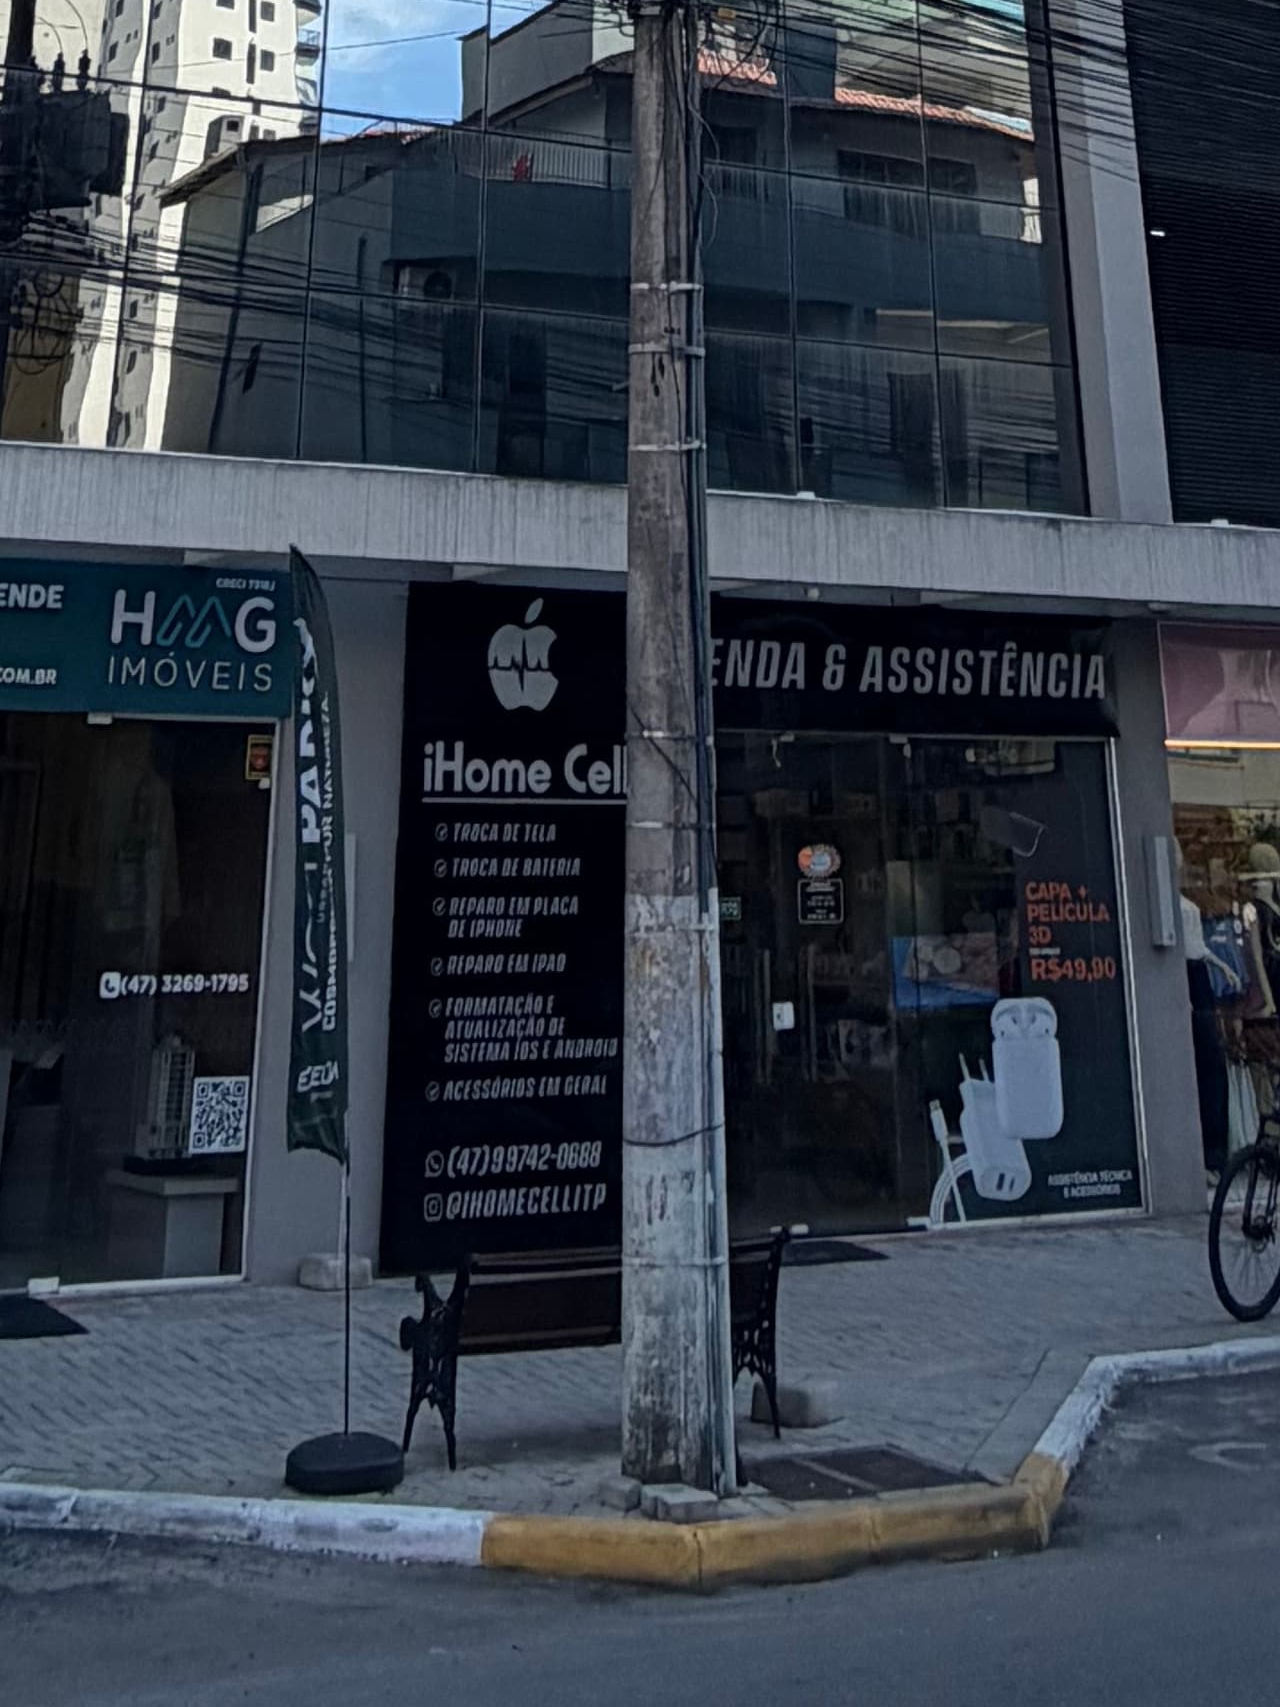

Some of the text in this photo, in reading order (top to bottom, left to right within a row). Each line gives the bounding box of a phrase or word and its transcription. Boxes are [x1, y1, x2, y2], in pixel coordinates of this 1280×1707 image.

[108, 651, 273, 692] IMÓVEIS
[710, 638, 1107, 699] ENDA & ASSISTÊNCIA
[423, 740, 552, 794] iHome
[453, 822, 557, 842] TROCA DE TELA
[452, 857, 581, 878] TROCA DE BATERIA
[1025, 881, 1072, 900] CAPA
[449, 896, 579, 916] REPARO EM PLACA
[448, 918, 466, 938] DE
[1028, 925, 1052, 945] 3D
[447, 953, 567, 975] REPARO EM IPAD
[120, 973, 249, 996] (47) 3269-1795
[445, 991, 555, 1017] FORMATAÇÃO E
[444, 1015, 566, 1040] ATUALIZAÇÃO DE
[444, 1041, 510, 1063] SISTEMA
[542, 1040, 551, 1060] E
[554, 1037, 619, 1060] ANDROID
[443, 1074, 608, 1102] ACESSÓRIOS EM GERAL
[446, 1183, 607, 1220] @IHOMECELLITP
